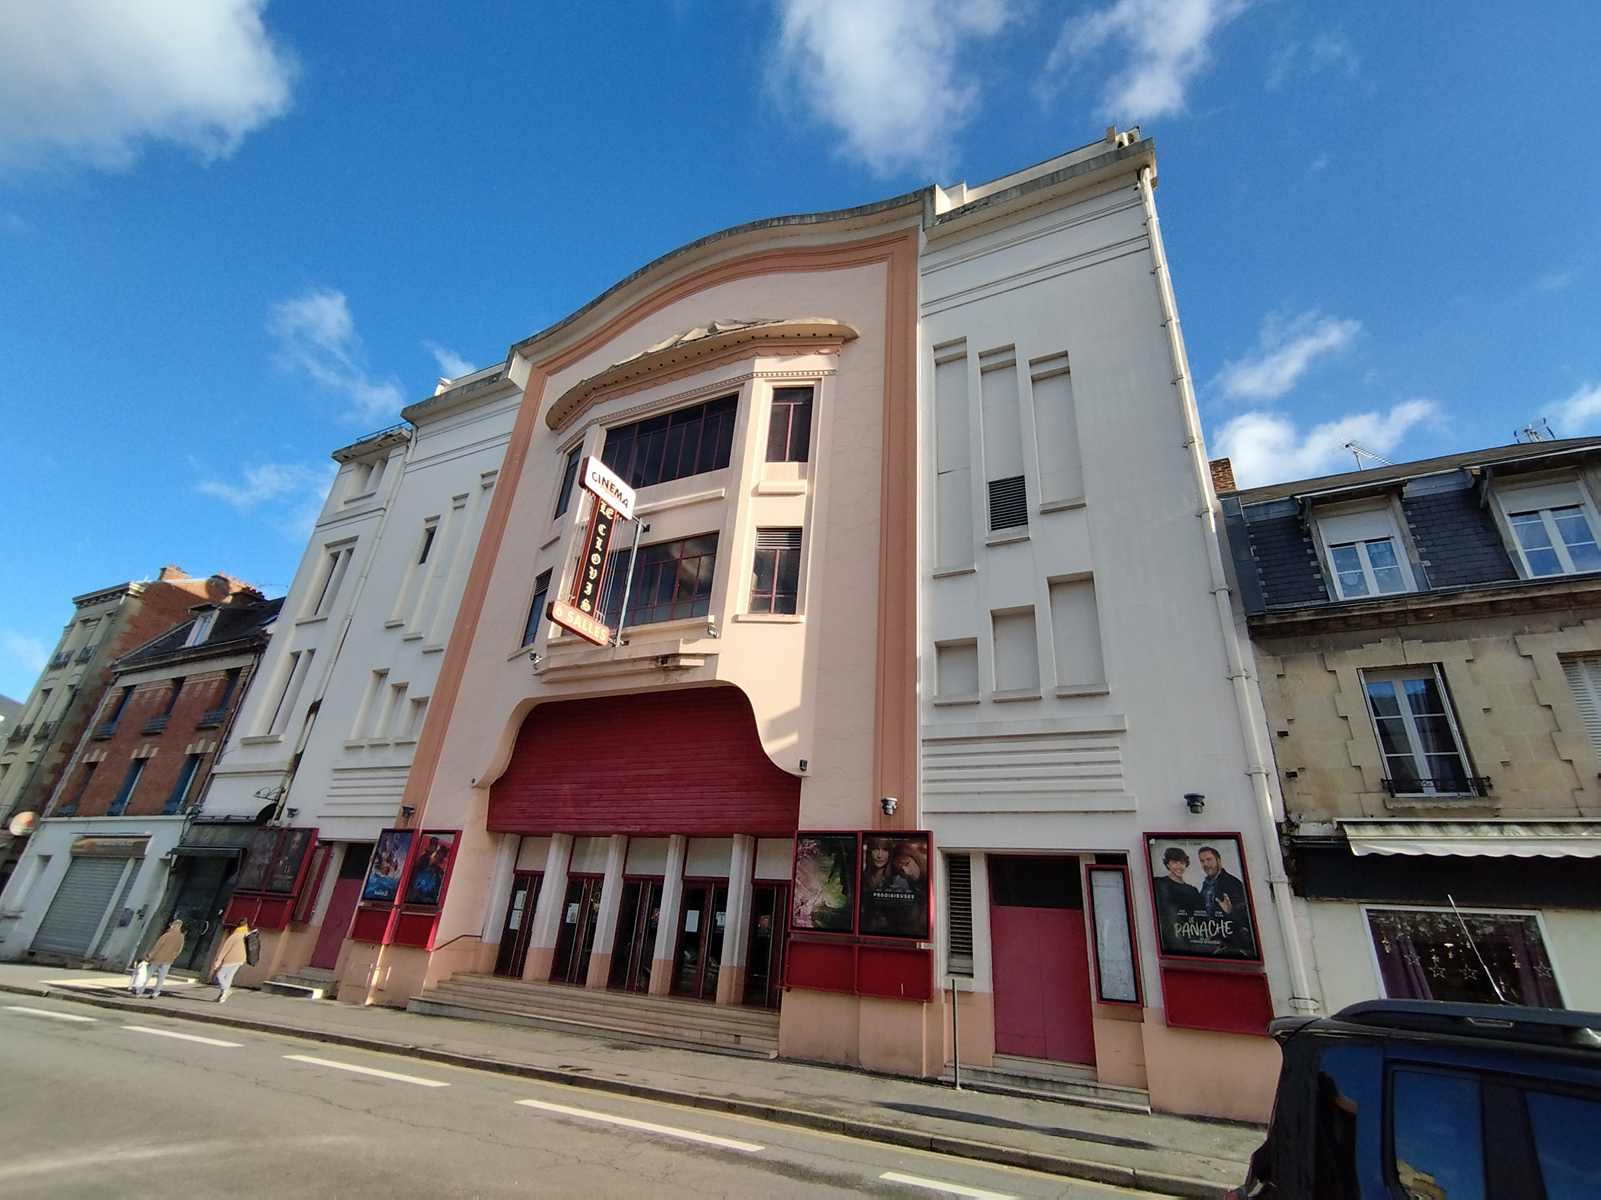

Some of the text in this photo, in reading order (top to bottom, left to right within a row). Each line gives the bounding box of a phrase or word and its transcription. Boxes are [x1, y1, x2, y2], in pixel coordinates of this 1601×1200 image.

[591, 471, 629, 508] CINEMA
[567, 610, 606, 640] SALLES
[1174, 919, 1234, 939] PANACHE
